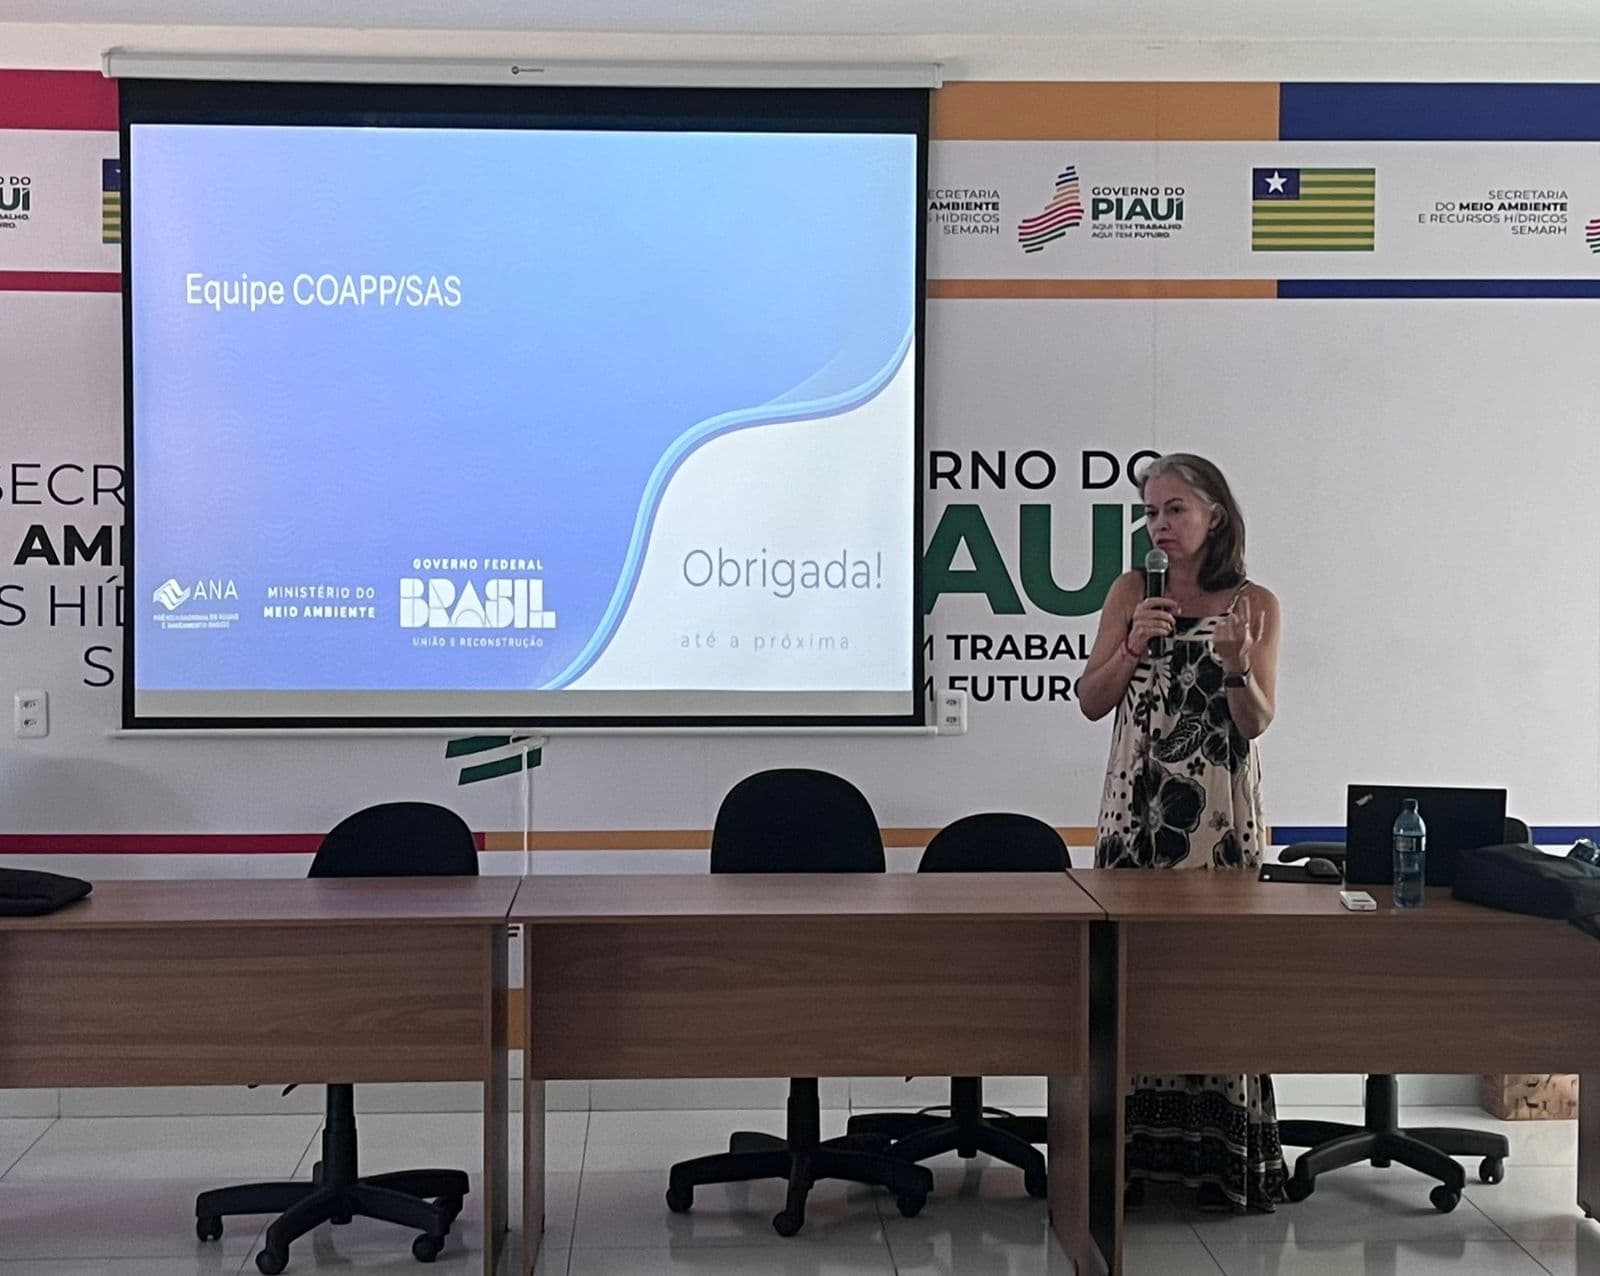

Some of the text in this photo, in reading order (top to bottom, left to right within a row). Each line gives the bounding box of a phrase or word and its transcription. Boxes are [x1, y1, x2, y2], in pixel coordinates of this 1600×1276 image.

[10, 176, 31, 185] DO
[1092, 187, 1185, 196] GOVERNO DO
[1488, 190, 1568, 200] SECRETARIA
[929, 202, 1000, 211] AMBIENTE
[1092, 198, 1183, 221] PIAUÍ
[1435, 202, 1568, 212] DO MEIO AMBIENTE
[1418, 212, 1568, 224] E RECURSOS HÍDRICOS
[943, 225, 1000, 235] SEMARH
[1511, 226, 1567, 235] SEMARH
[186, 272, 462, 312] Equipe COAPP/SAS
[0, 463, 125, 506] ECR
[14, 525, 125, 566] AM
[413, 558, 543, 571] GOVERNO FEDERAL
[683, 547, 882, 598] Obrigada!
[193, 579, 239, 601] ANA
[267, 585, 375, 599] MINISTÉRIO DO
[50, 575, 125, 627] HÍ
[400, 578, 556, 629] BRASIL
[264, 606, 376, 619] MEIO AMBIENTE
[412, 637, 446, 648] UNIÃO
[460, 636, 544, 649] RECONSTRUÇÃO
[681, 632, 850, 652] até a próxima
